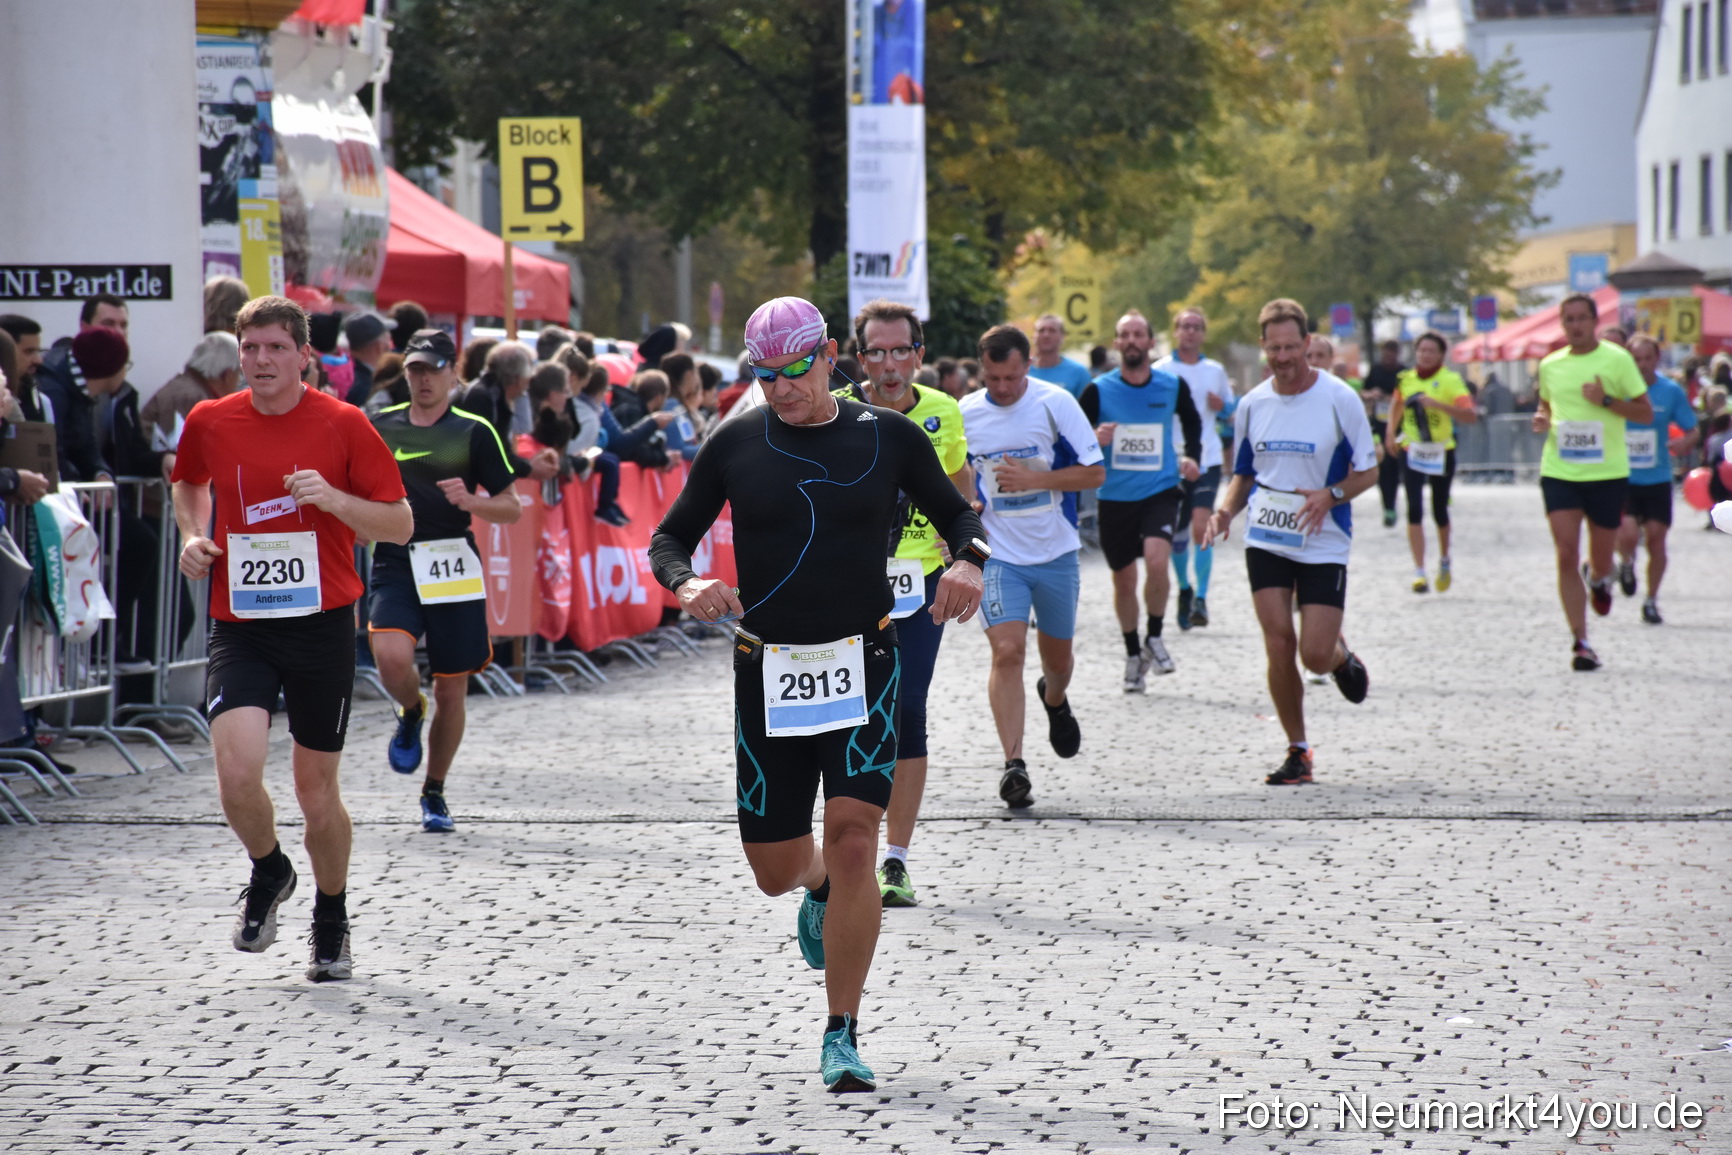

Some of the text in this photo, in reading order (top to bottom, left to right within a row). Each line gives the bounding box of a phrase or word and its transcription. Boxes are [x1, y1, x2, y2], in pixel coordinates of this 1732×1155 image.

[509, 124, 571, 146] Block
[522, 157, 562, 214] B
[0, 268, 162, 297] NI-Partl.de
[1065, 292, 1088, 327] C
[1678, 311, 1695, 334] D
[1120, 438, 1155, 453] 2653
[259, 503, 283, 516] DEHN
[1257, 508, 1299, 530] 2008
[259, 541, 290, 550] BOCK
[241, 557, 305, 586] 2230
[429, 557, 466, 579] 414
[255, 594, 293, 604] Andreas
[800, 649, 836, 661] BOCK
[779, 667, 851, 701] 2913
